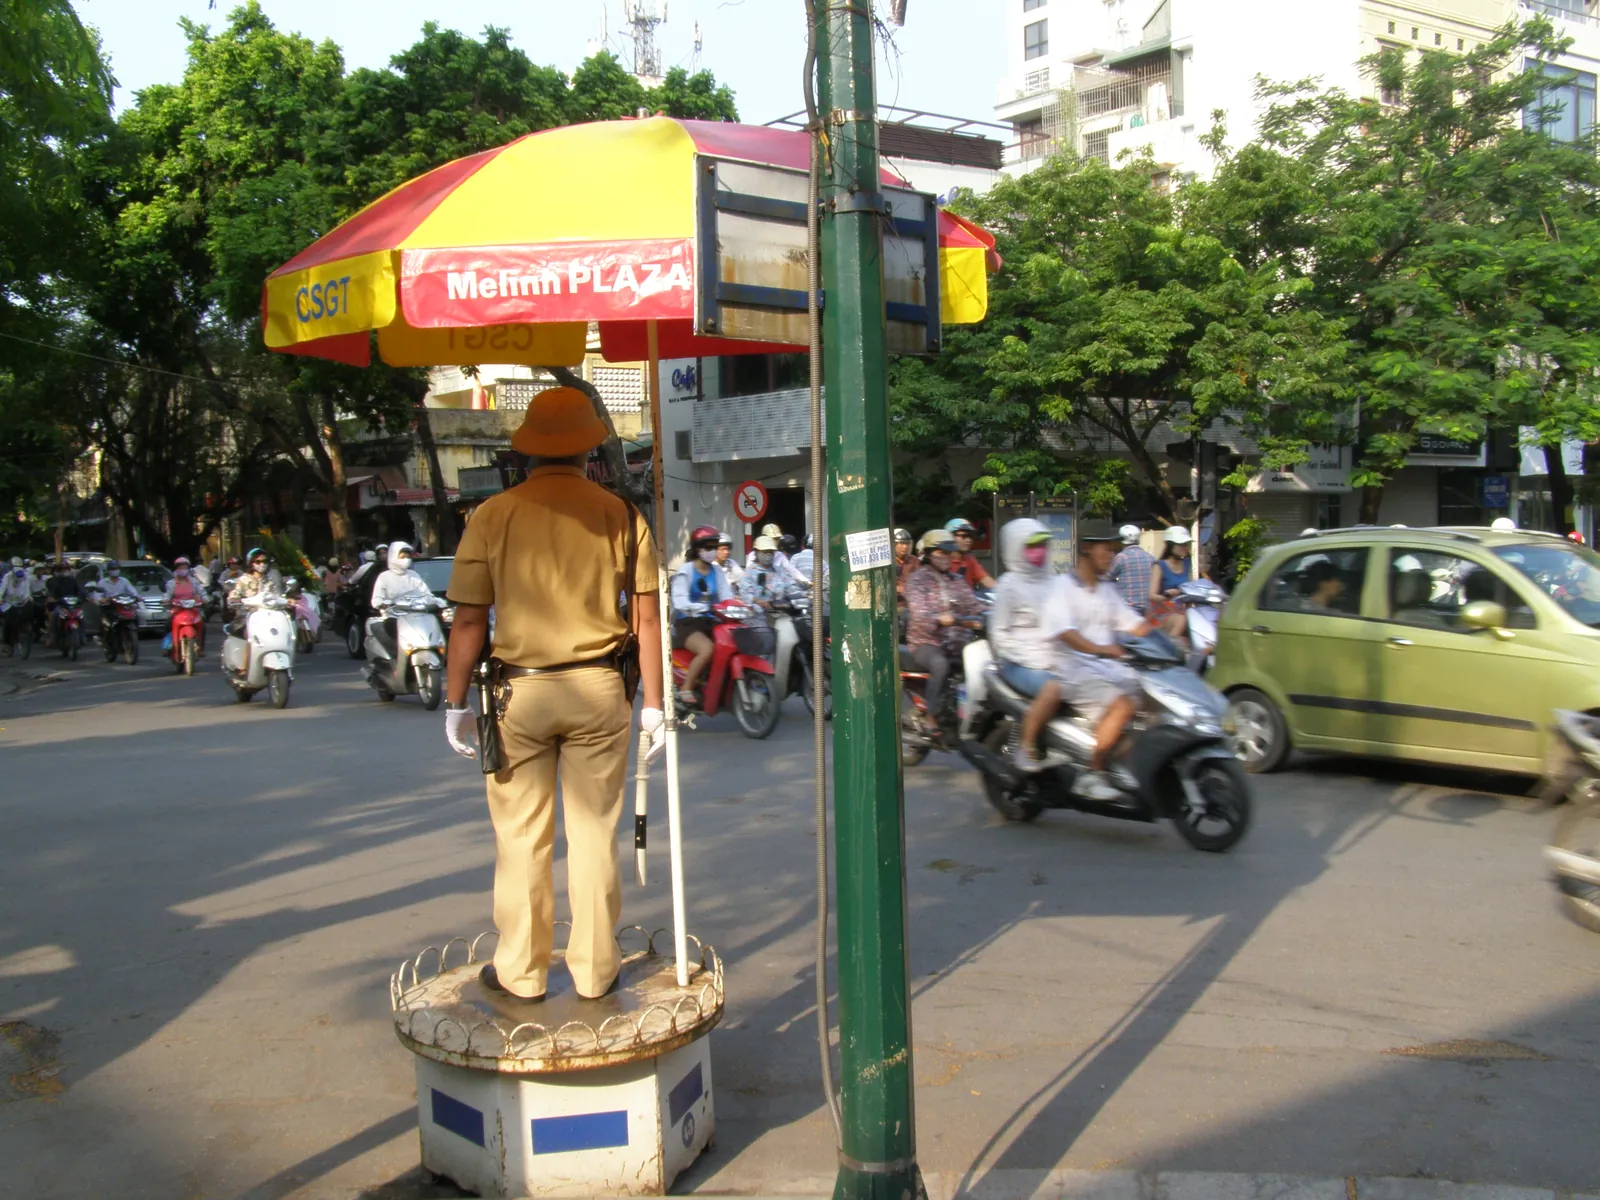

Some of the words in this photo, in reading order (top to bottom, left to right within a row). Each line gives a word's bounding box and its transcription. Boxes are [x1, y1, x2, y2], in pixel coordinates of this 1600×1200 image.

[295, 276, 351, 323] CSGT
[447, 268, 561, 300] Melinh
[568, 261, 692, 296] PLAZA
